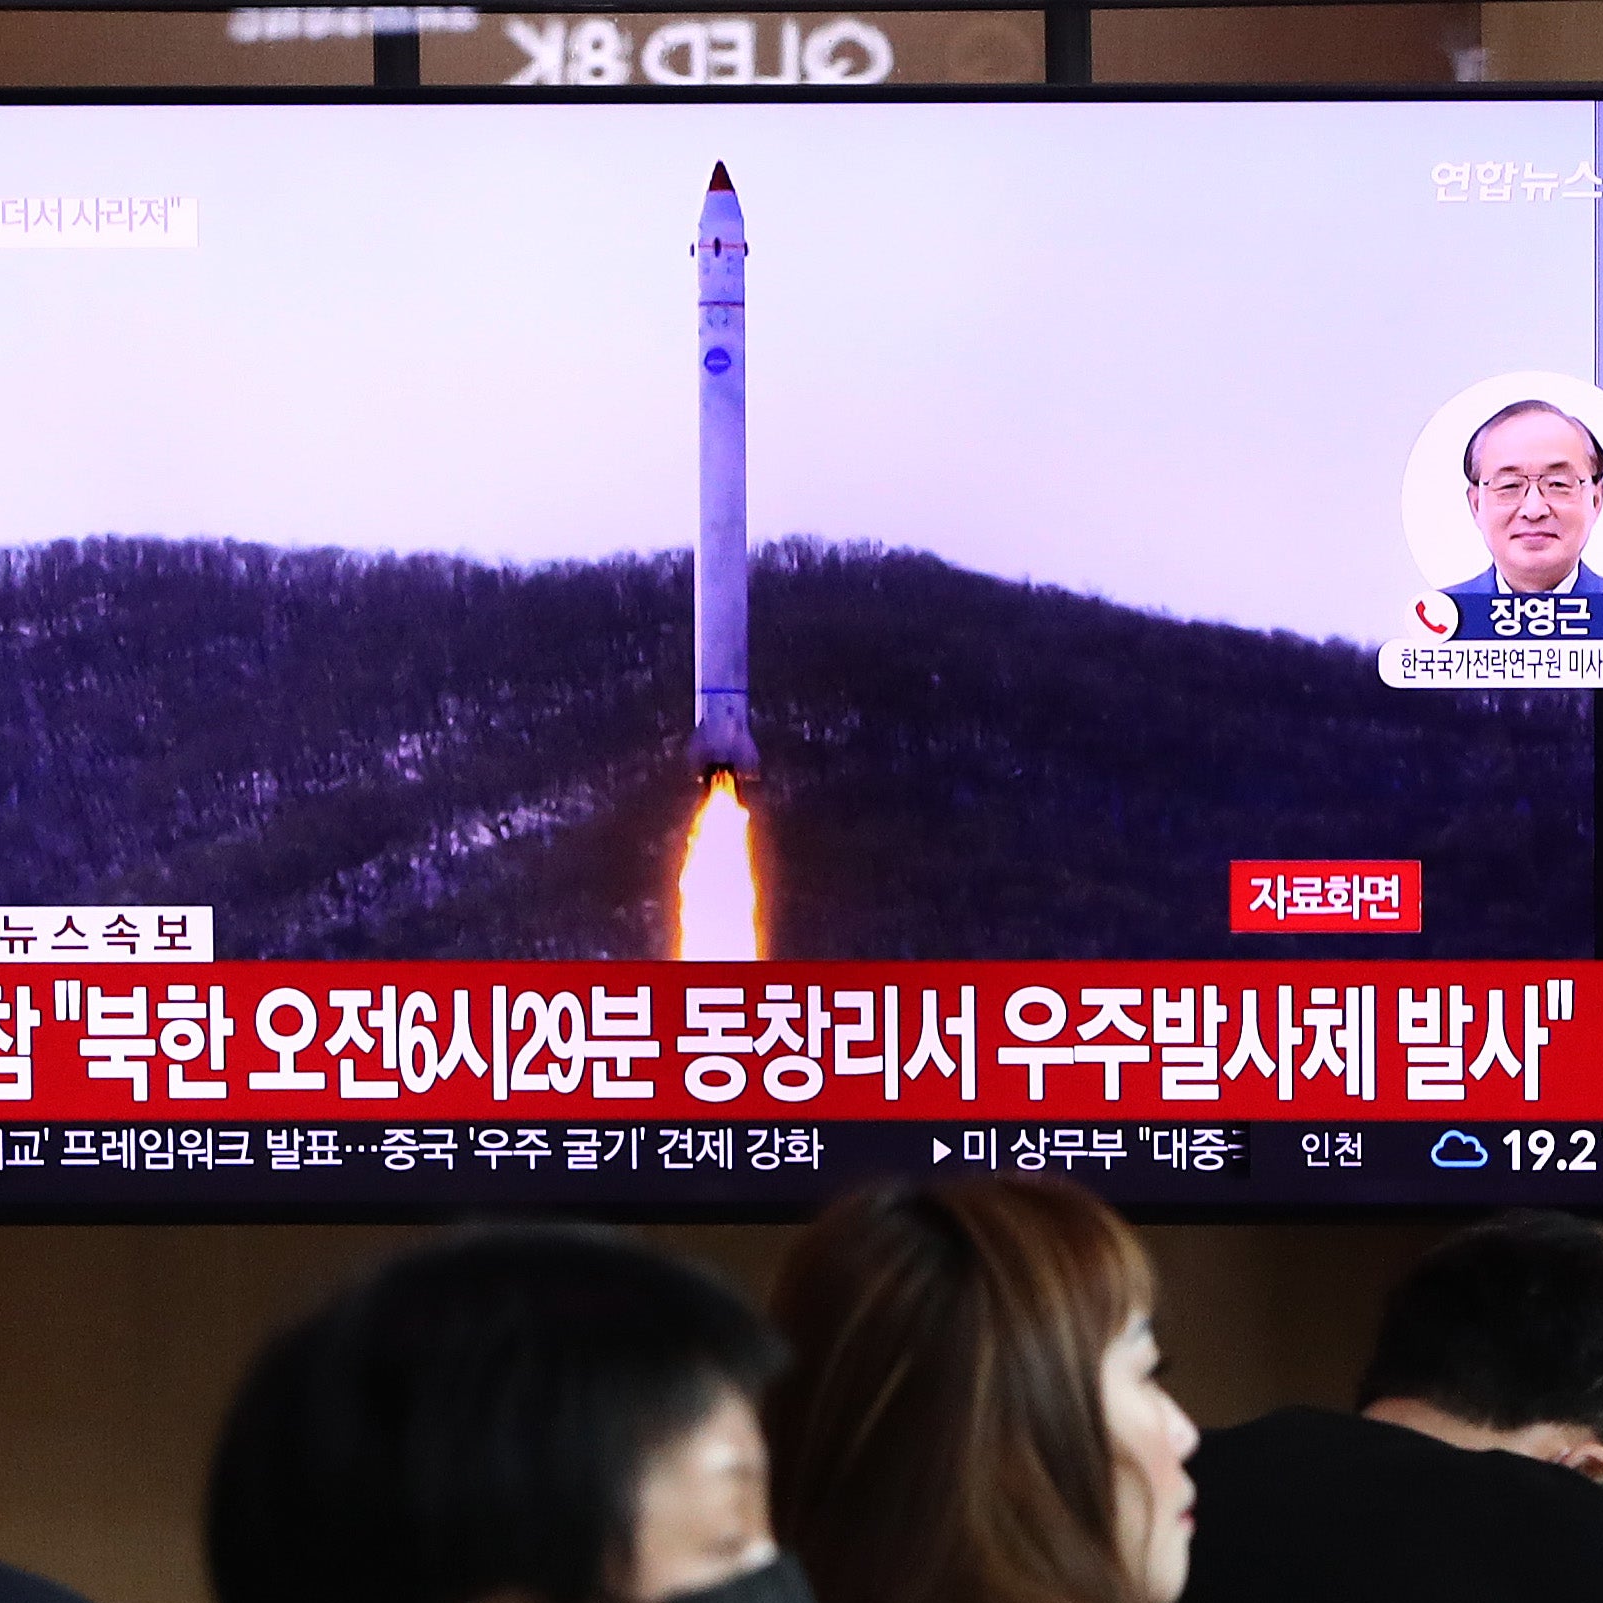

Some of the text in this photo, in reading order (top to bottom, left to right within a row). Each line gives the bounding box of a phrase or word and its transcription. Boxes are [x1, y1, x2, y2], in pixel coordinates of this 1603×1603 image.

[71, 197, 182, 234] 사라져"
[1489, 596, 1591, 637] 장영근
[1401, 648, 1562, 681] 한국국가전략연구원
[1248, 874, 1401, 920] 자료화면
[0, 913, 193, 955] 뉴스속보
[53, 979, 235, 1102] "북한
[248, 984, 660, 1102] 오전6시29분
[676, 984, 976, 1102] 동창리서
[997, 984, 1377, 1102] 우주발사체
[1398, 979, 1574, 1102] 발사"
[60, 1127, 254, 1171] 프레임워크
[468, 1126, 553, 1170] '우주
[562, 1126, 646, 1170] 굴기'
[656, 1127, 735, 1171] 견제
[745, 1127, 824, 1171] 강화
[963, 1127, 997, 1171] 미
[1010, 1127, 1128, 1171] 상무부
[1301, 1131, 1363, 1168] 인천
